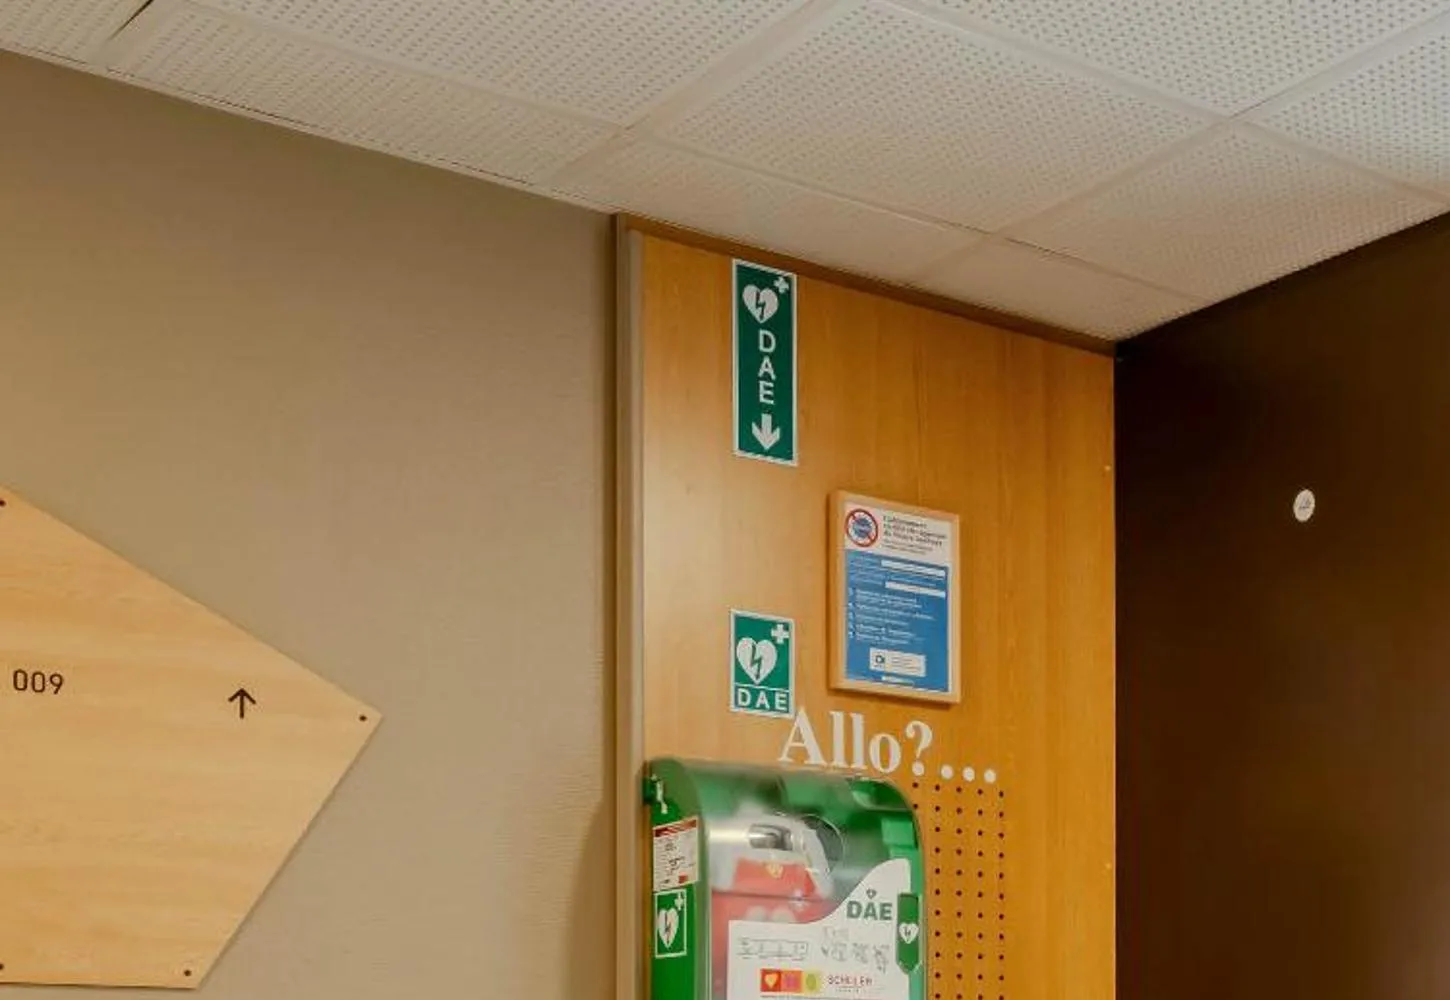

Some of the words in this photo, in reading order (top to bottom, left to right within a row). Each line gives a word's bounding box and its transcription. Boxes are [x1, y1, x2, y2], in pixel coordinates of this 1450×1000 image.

[758, 328, 776, 405] DAE
[13, 669, 64, 695] 009
[738, 688, 788, 710] DAE
[846, 900, 893, 921] DAE
